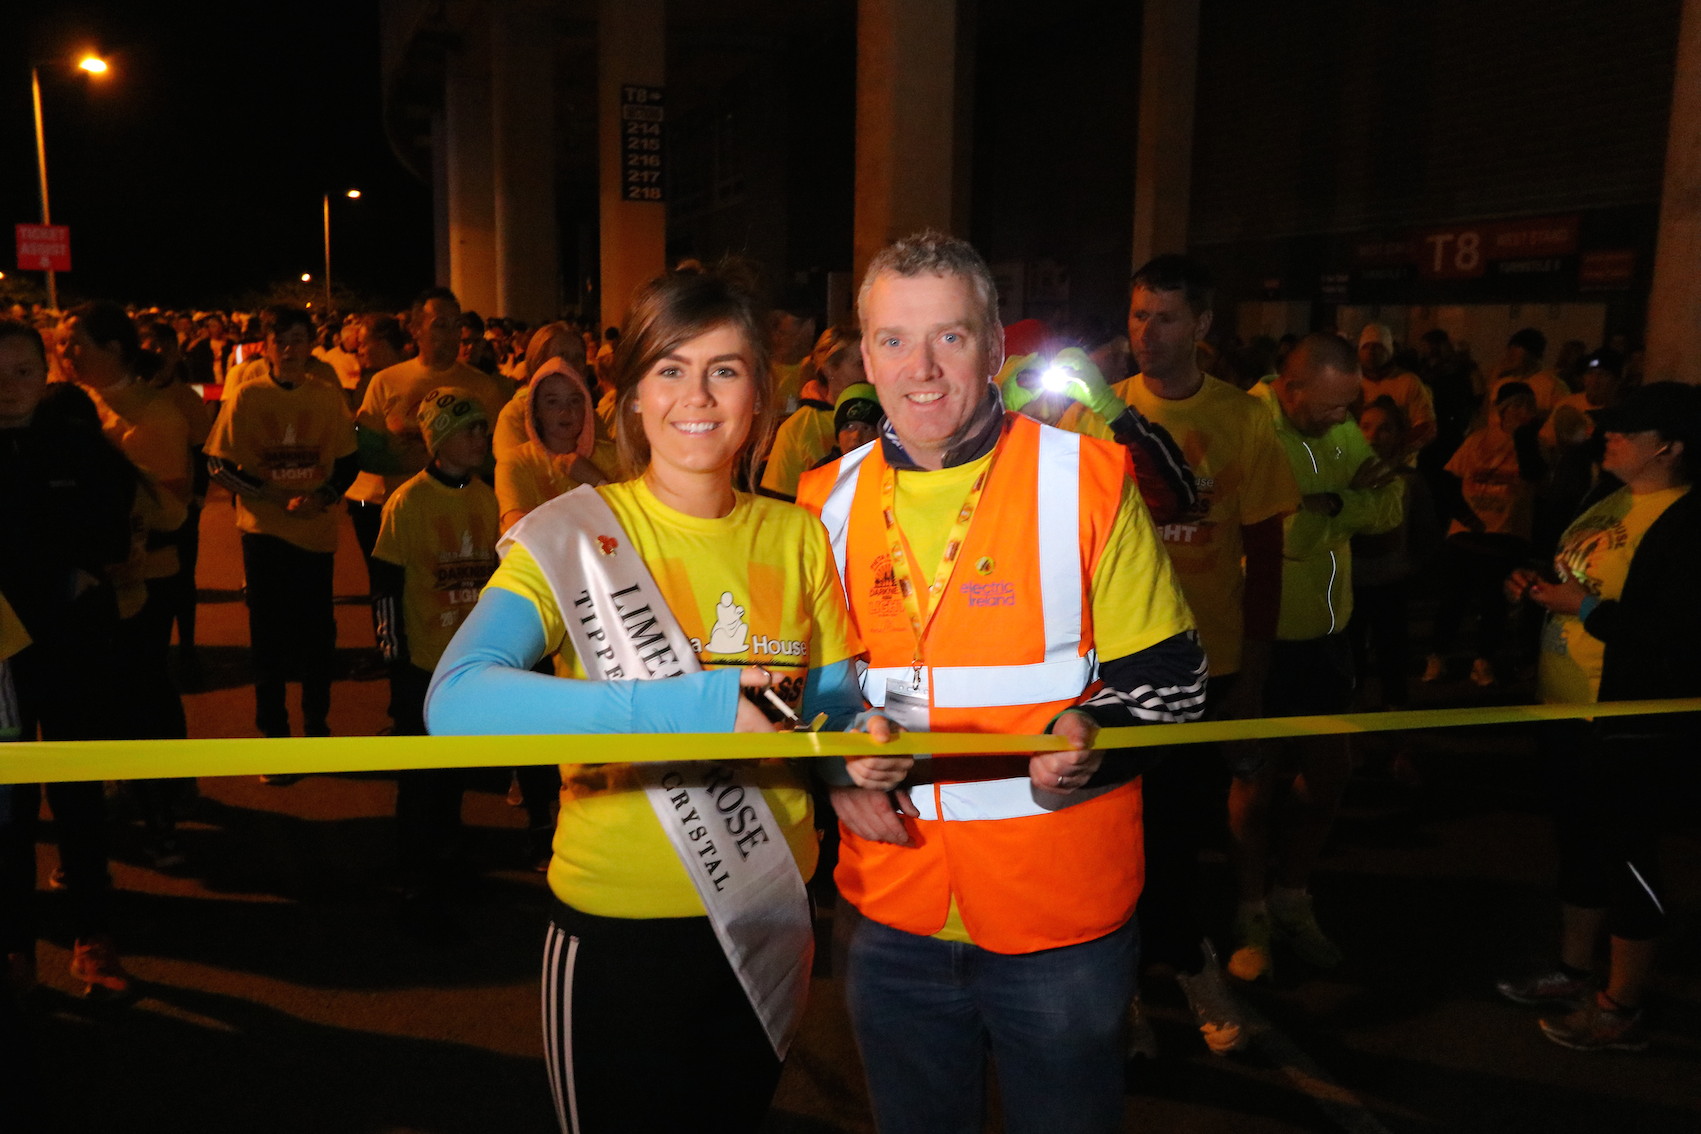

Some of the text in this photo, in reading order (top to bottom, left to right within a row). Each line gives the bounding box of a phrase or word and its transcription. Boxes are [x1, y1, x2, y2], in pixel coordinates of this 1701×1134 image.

[623, 86, 648, 103] T8
[626, 121, 661, 136] 214
[627, 137, 661, 151] 215
[627, 153, 661, 168] 216
[627, 169, 661, 183] 217
[627, 185, 662, 200] 218
[20, 226, 65, 241] TICKET
[1424, 231, 1481, 273] T8
[960, 580, 1016, 594] electric
[752, 635, 807, 656] House
[703, 765, 770, 863] ROSE
[661, 771, 730, 892] CRYSTAL
